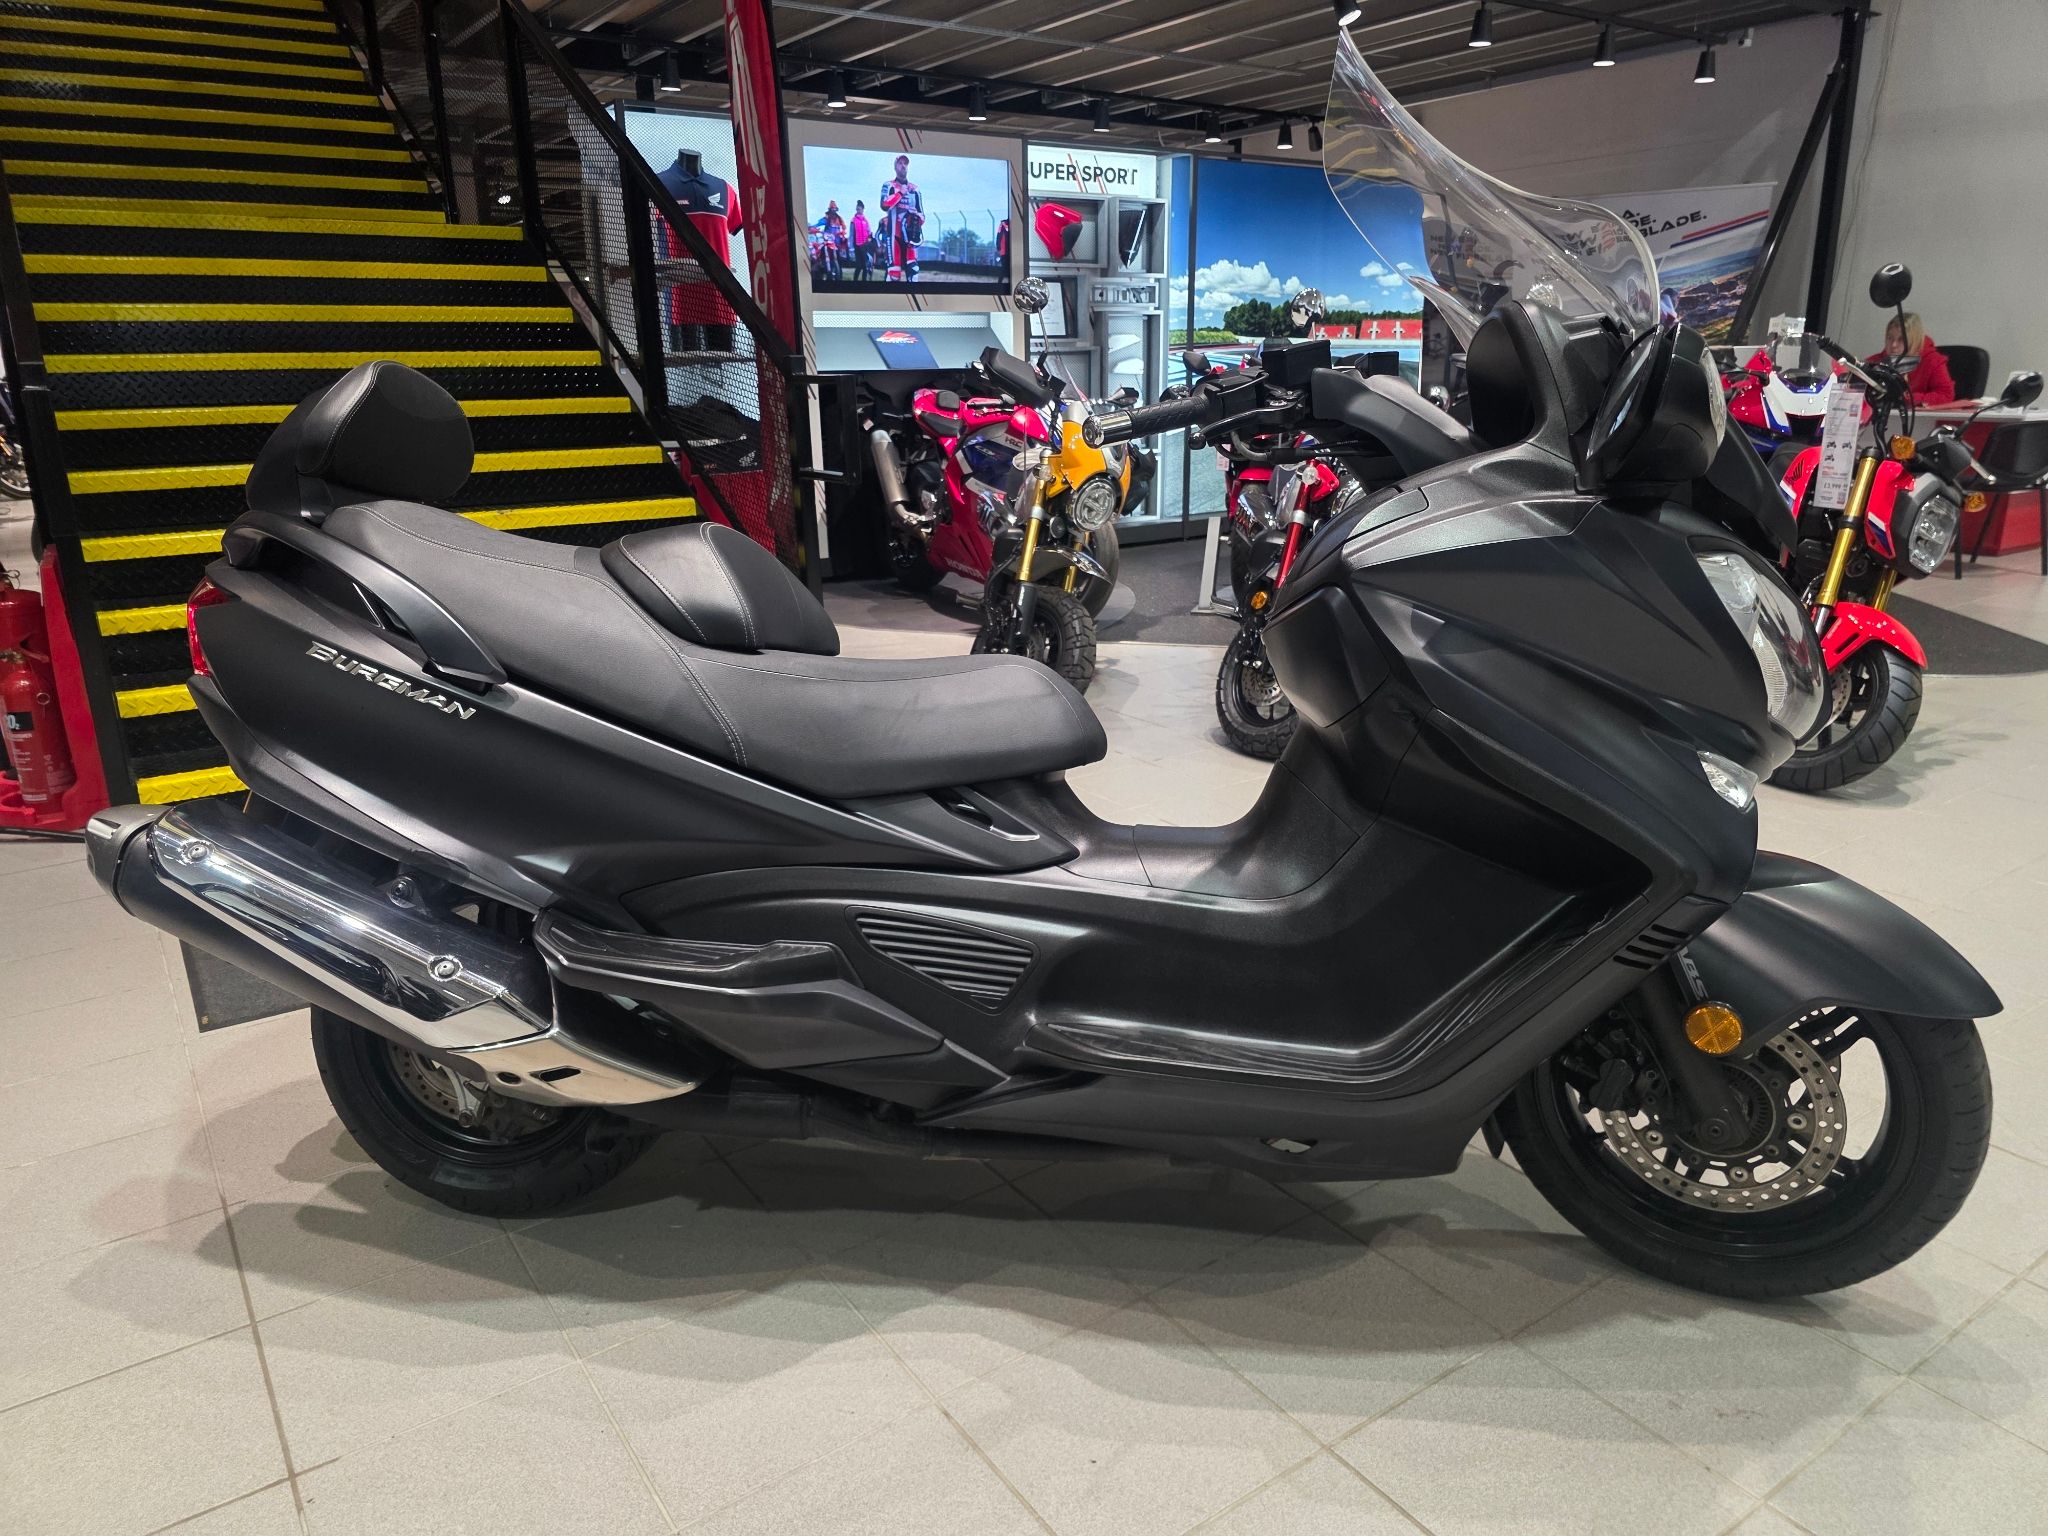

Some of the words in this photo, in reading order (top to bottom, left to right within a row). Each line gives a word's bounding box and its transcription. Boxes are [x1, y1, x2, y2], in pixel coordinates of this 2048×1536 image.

[1030, 162, 1077, 181] UPER
[1082, 165, 1138, 185] SPORT
[1640, 210, 1708, 238] BLADE.
[305, 640, 476, 720] BURGMAN
